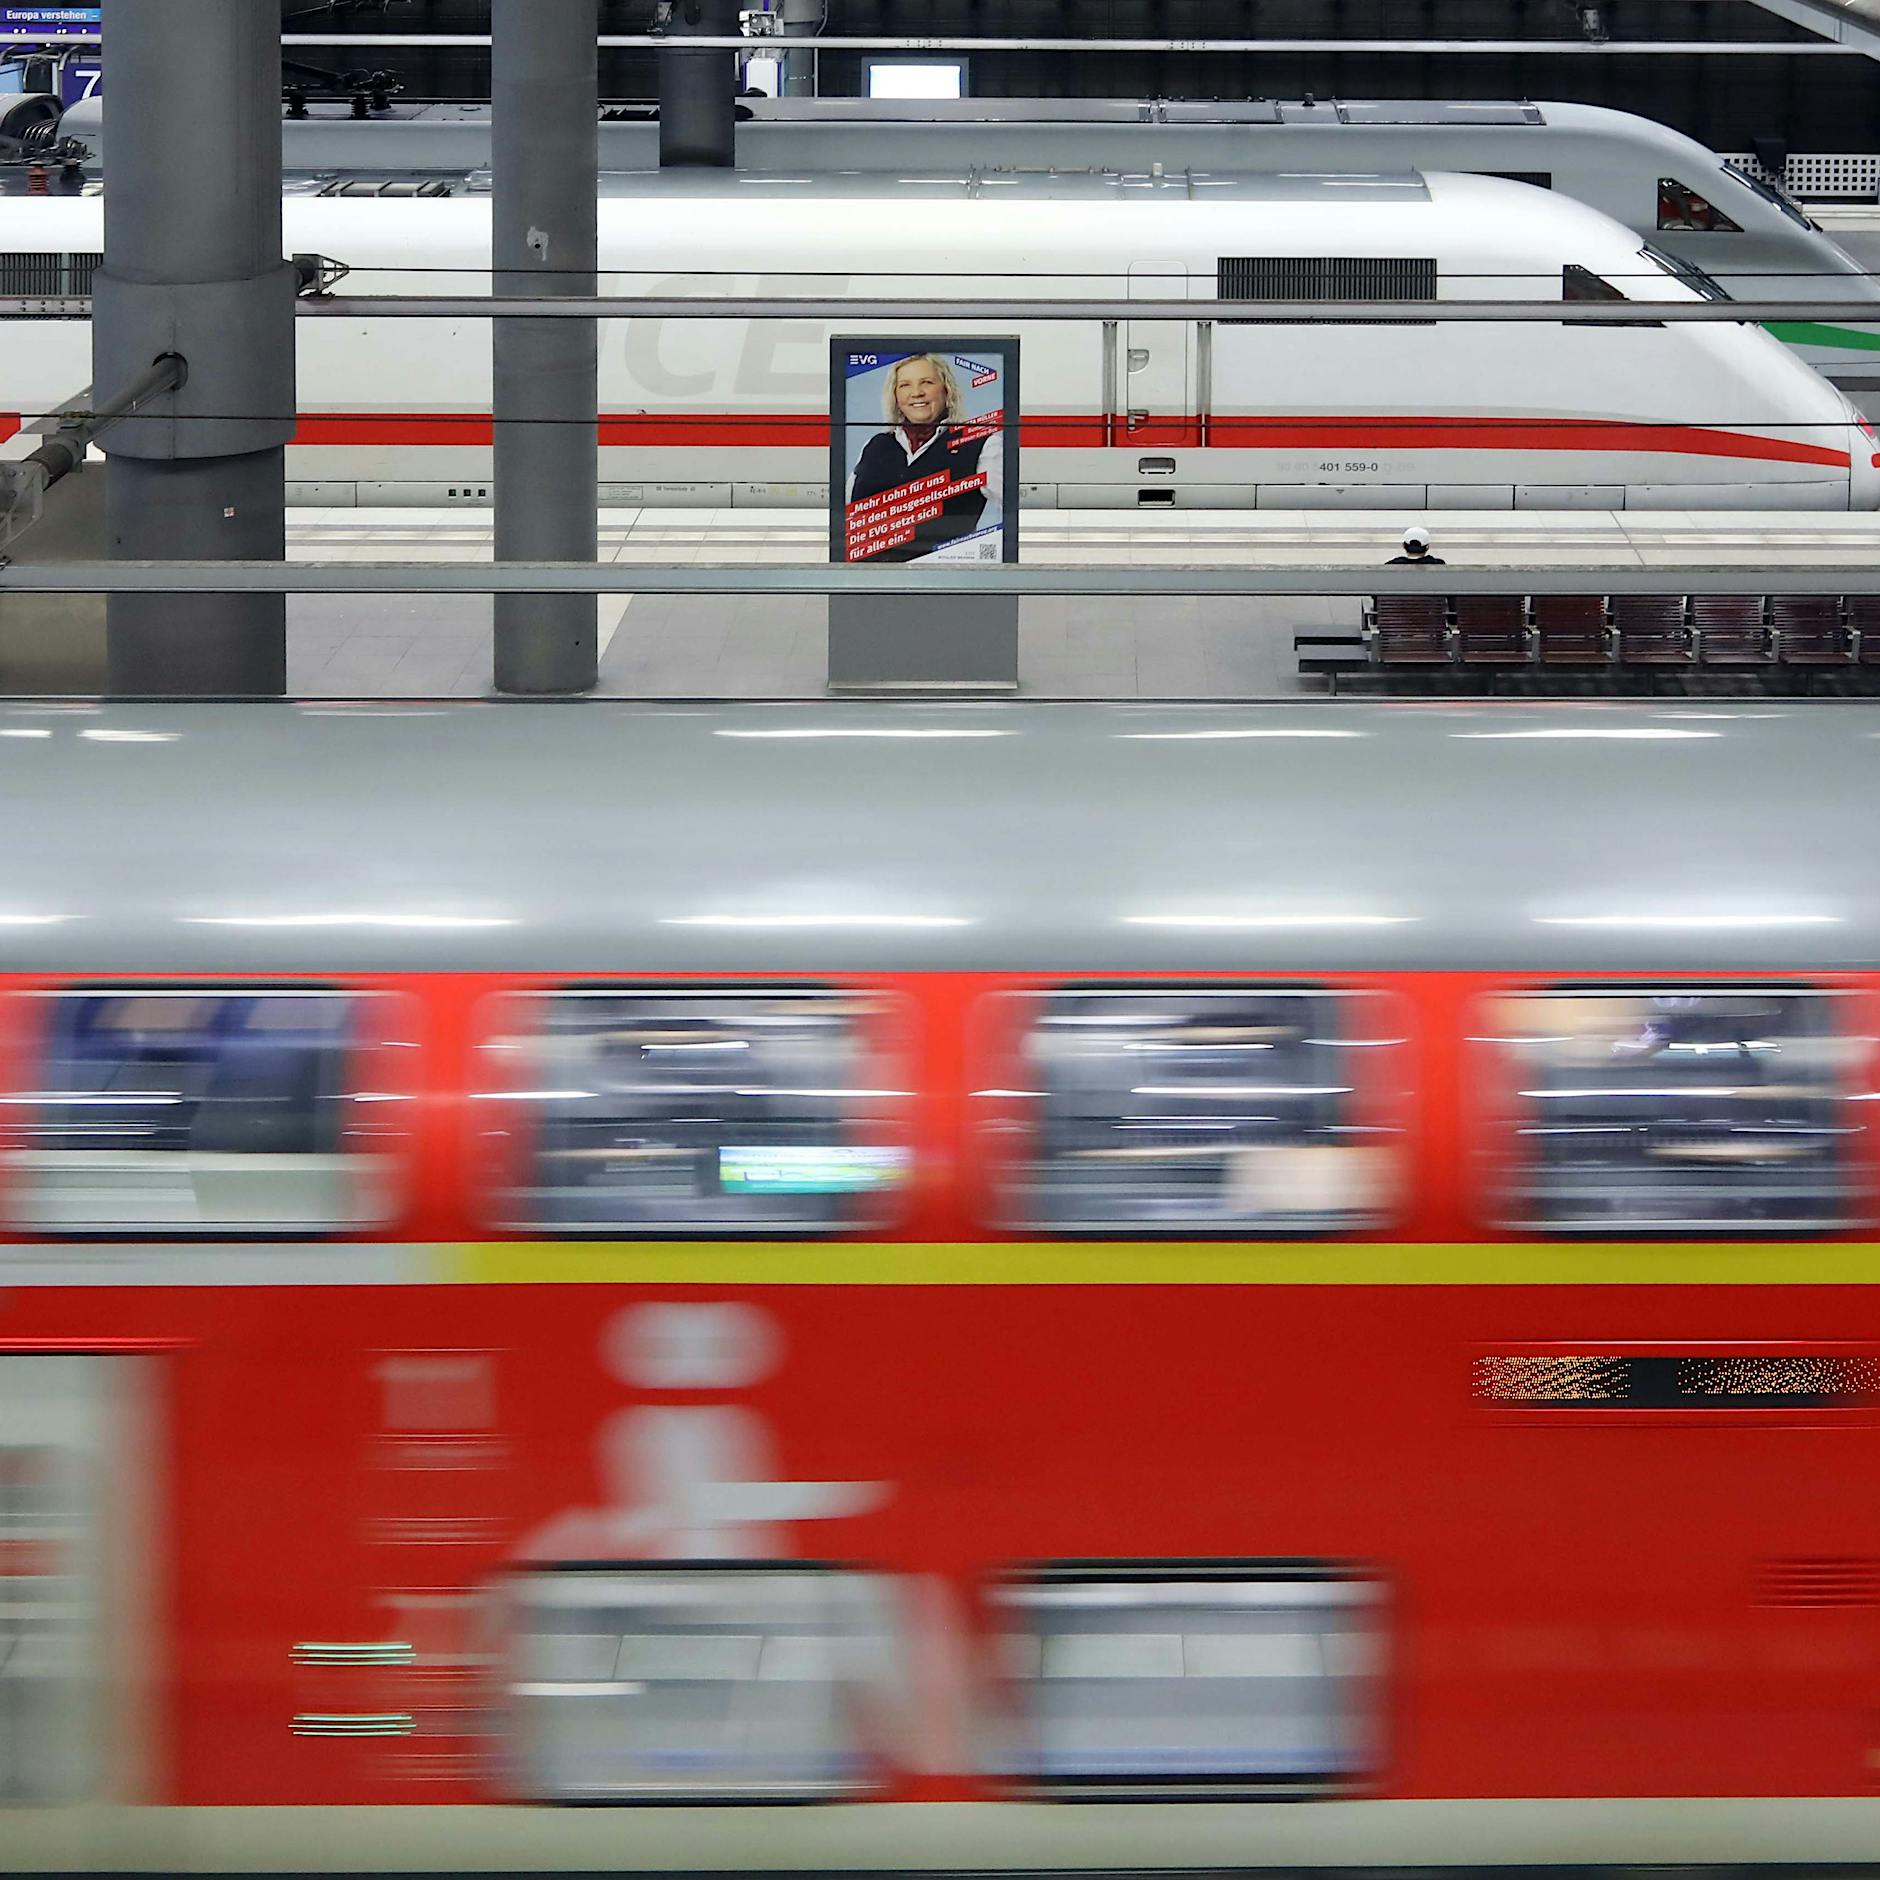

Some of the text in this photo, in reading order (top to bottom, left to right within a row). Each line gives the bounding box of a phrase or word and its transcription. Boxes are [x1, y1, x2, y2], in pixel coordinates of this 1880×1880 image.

[6, 10, 39, 21] Europa
[41, 10, 87, 20] verstehen
[75, 70, 101, 100] 7
[849, 354, 878, 365] EVG
[956, 358, 990, 374] FAIR NACH
[973, 372, 996, 386] VORNE
[1344, 462, 1378, 472] 559-0
[849, 475, 945, 517] „Mehr Lohn für uns
[849, 477, 983, 530] bei den Busgesellschaften.
[849, 506, 938, 545] Die EVG setzt sich
[849, 546, 865, 560] für
[866, 540, 886, 554] alle
